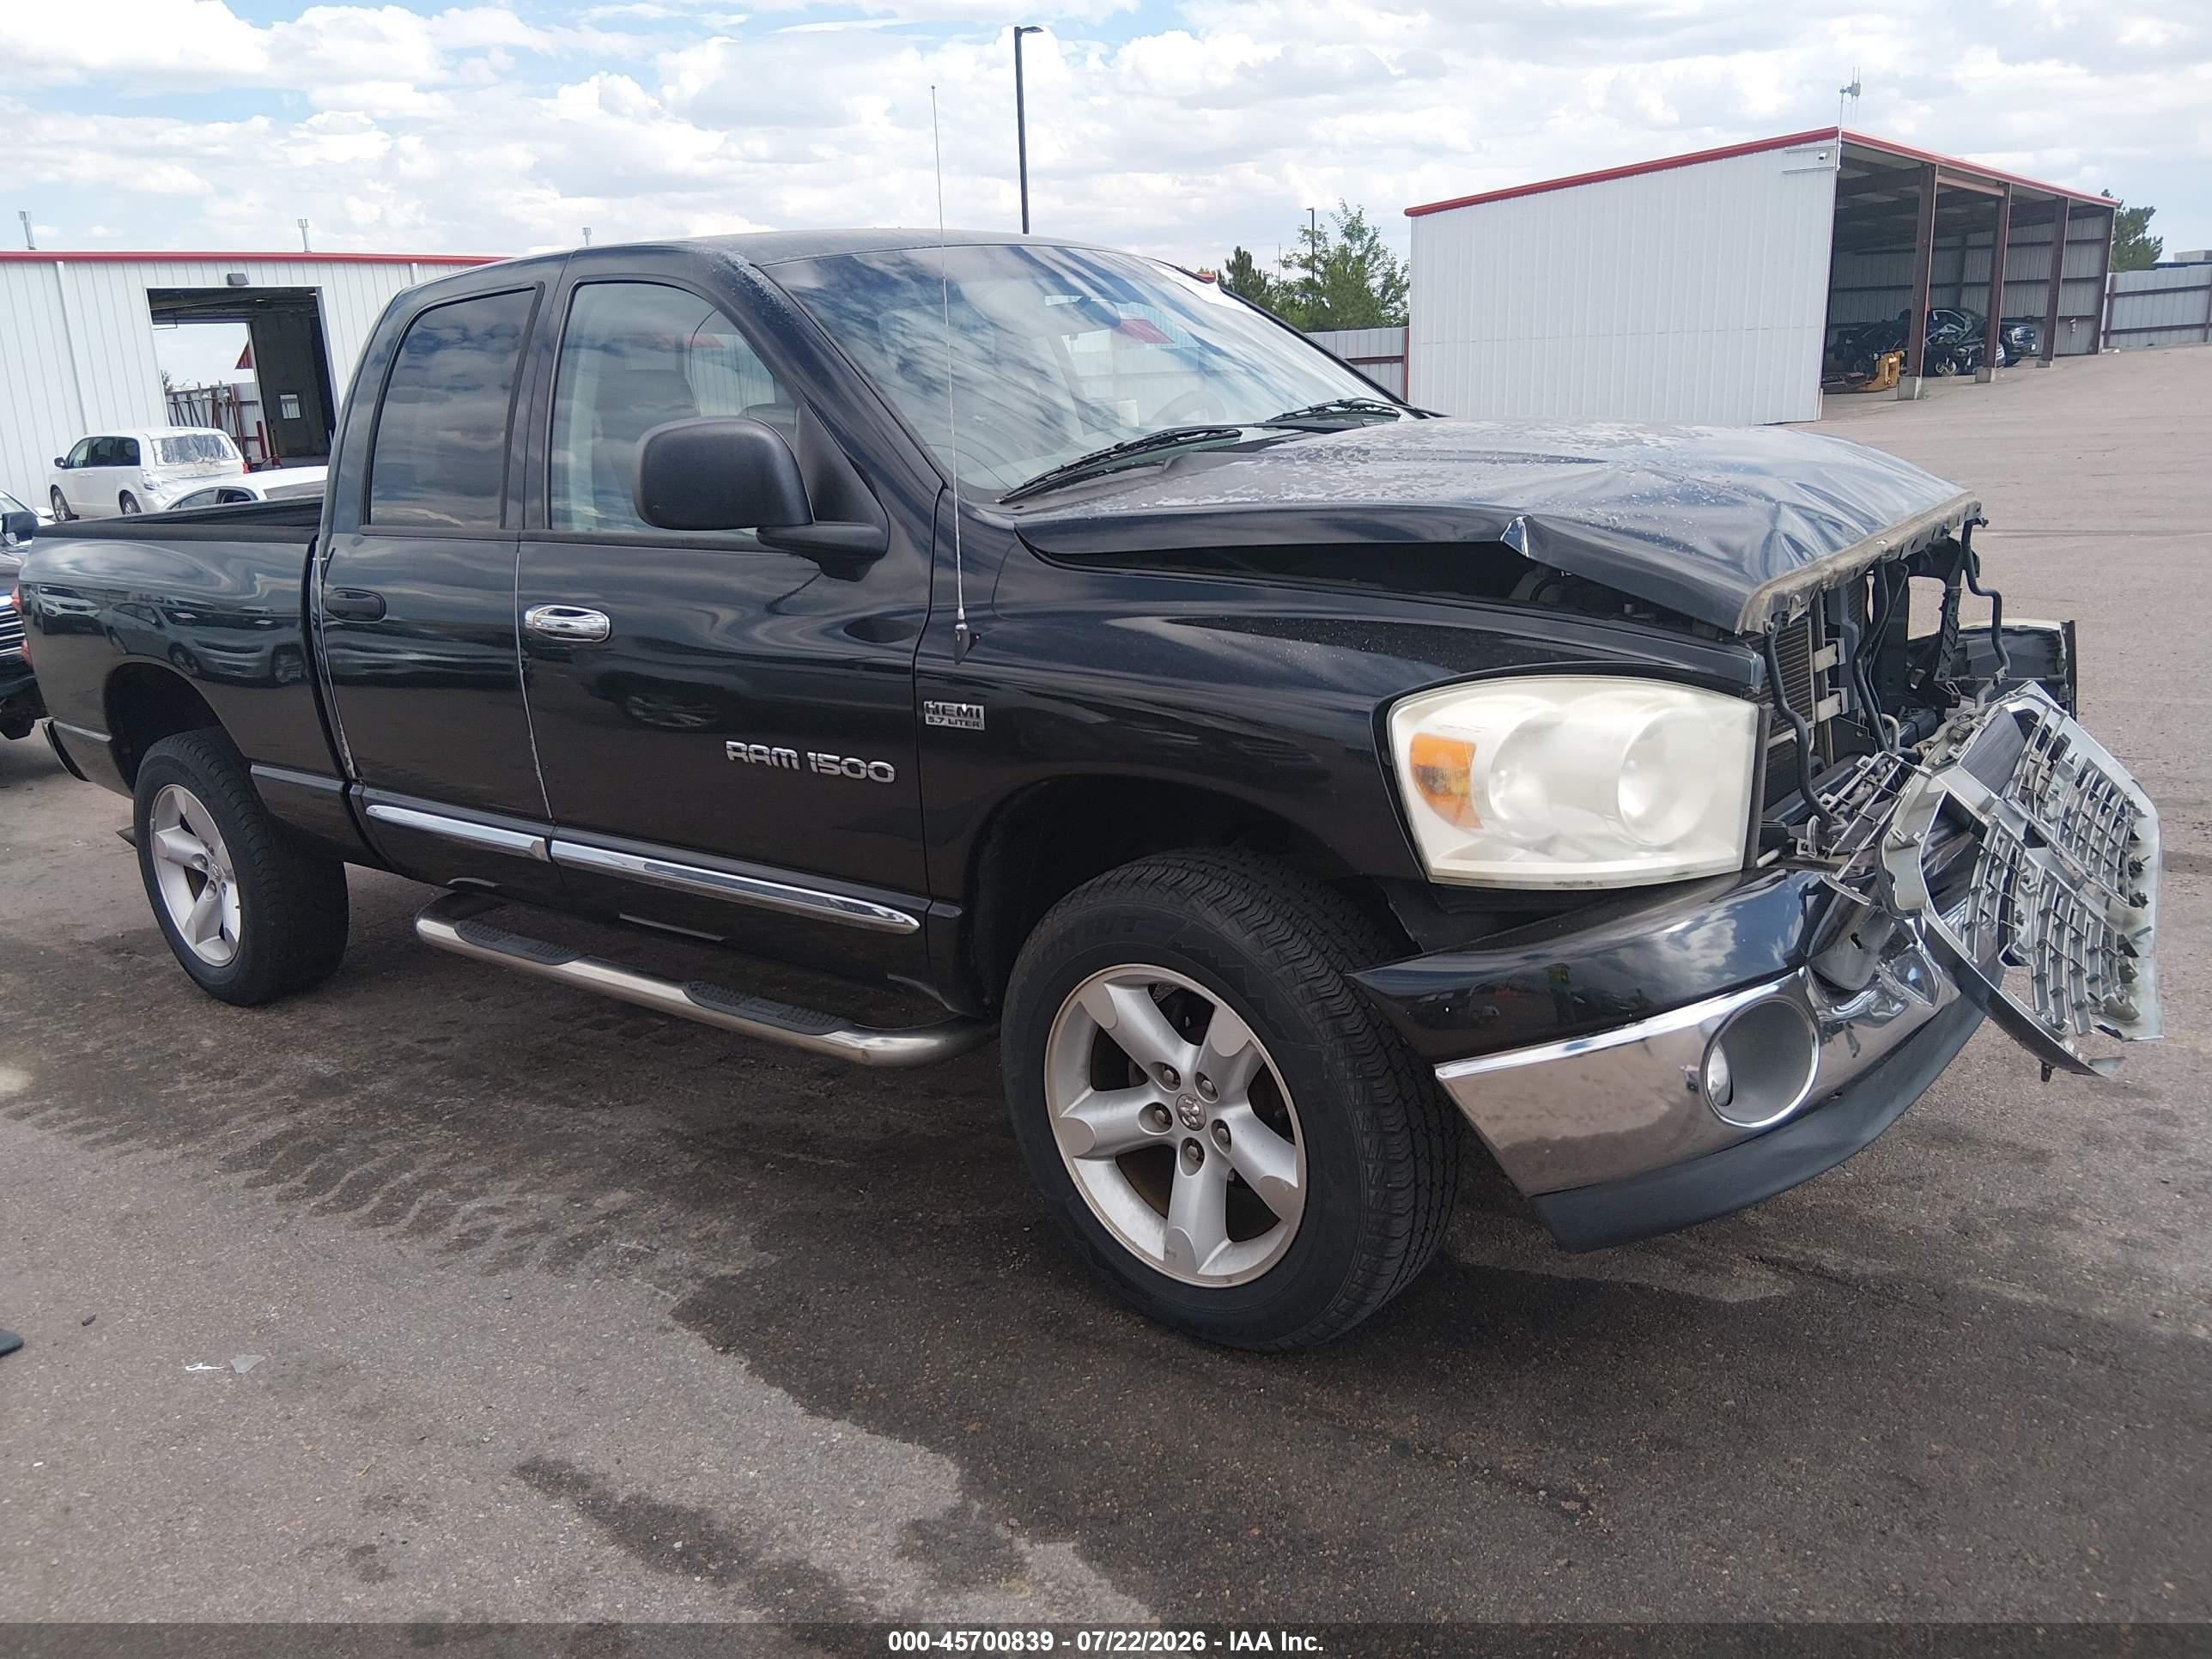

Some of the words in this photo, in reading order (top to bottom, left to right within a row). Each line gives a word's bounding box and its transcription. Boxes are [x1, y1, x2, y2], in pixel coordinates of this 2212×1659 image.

[925, 702, 981, 719] HEMI
[927, 716, 945, 725] 5.7
[947, 718, 981, 728] LITER
[726, 740, 800, 770] RAM
[807, 751, 895, 783] 1500
